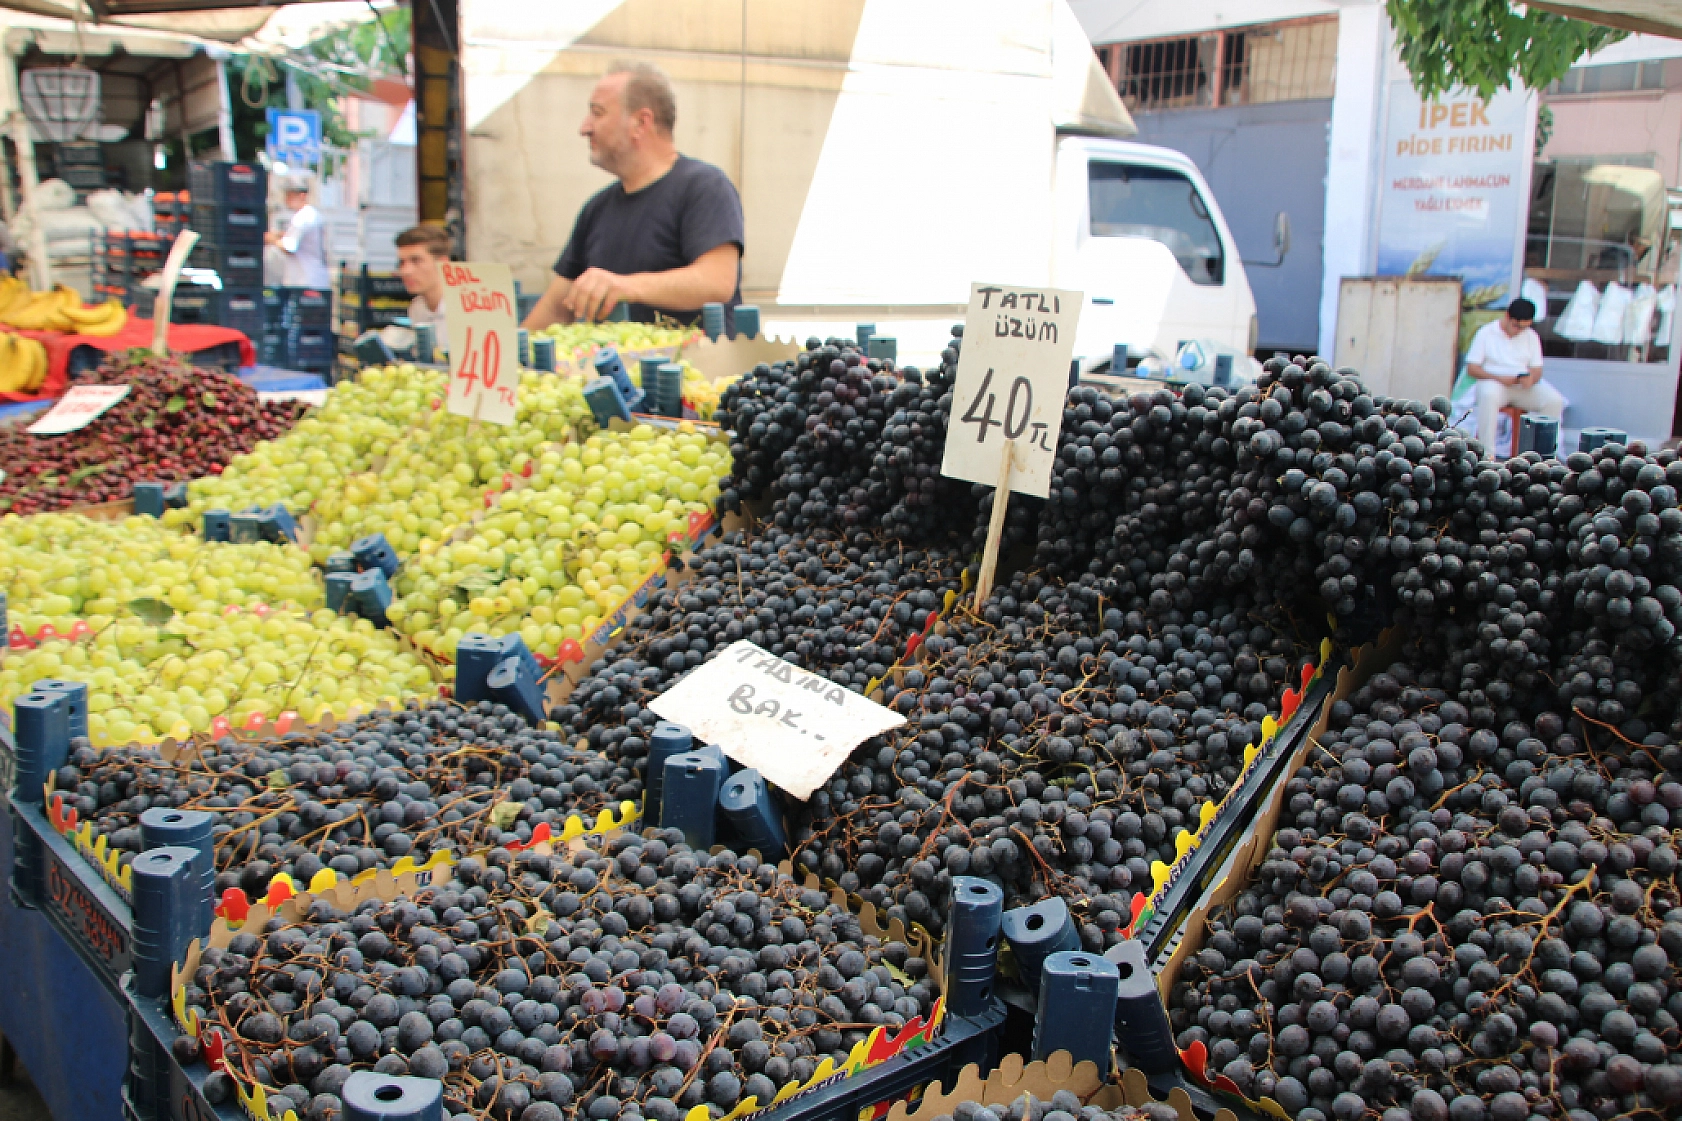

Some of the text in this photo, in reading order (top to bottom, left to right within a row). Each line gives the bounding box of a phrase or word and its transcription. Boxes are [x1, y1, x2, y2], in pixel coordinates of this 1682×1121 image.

[278, 116, 308, 147] P
[1396, 133, 1513, 156] PİDE FIRINI
[442, 262, 481, 286] BAL
[977, 285, 1061, 314] TATLI
[994, 313, 1059, 343] ÜZÜM
[457, 326, 501, 397] 40
[960, 366, 1052, 451] 40 TL
